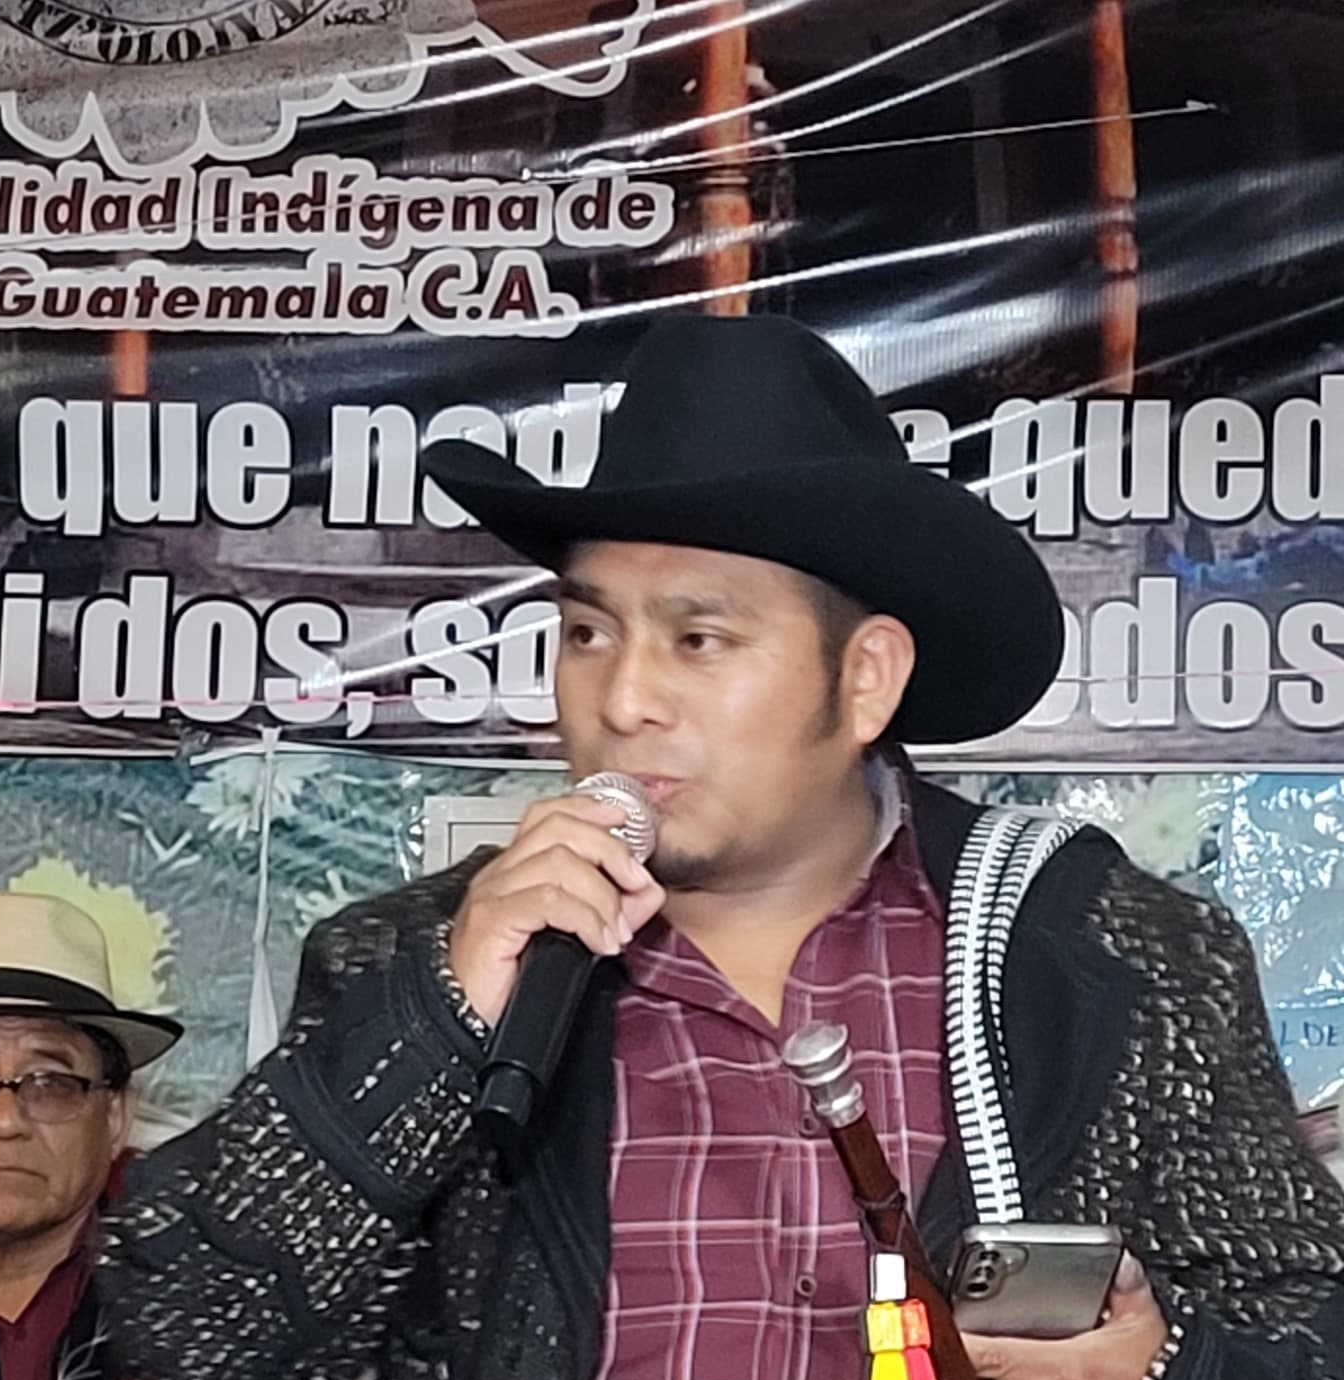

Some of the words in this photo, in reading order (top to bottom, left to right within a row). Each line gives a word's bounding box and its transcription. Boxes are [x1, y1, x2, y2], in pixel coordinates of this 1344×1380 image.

[210, 168, 540, 249] Indígena
[567, 174, 660, 236] de
[418, 260, 568, 323] C.A.
[19, 397, 293, 536] que
[330, 383, 602, 528] nad
[79, 574, 374, 739] dos,
